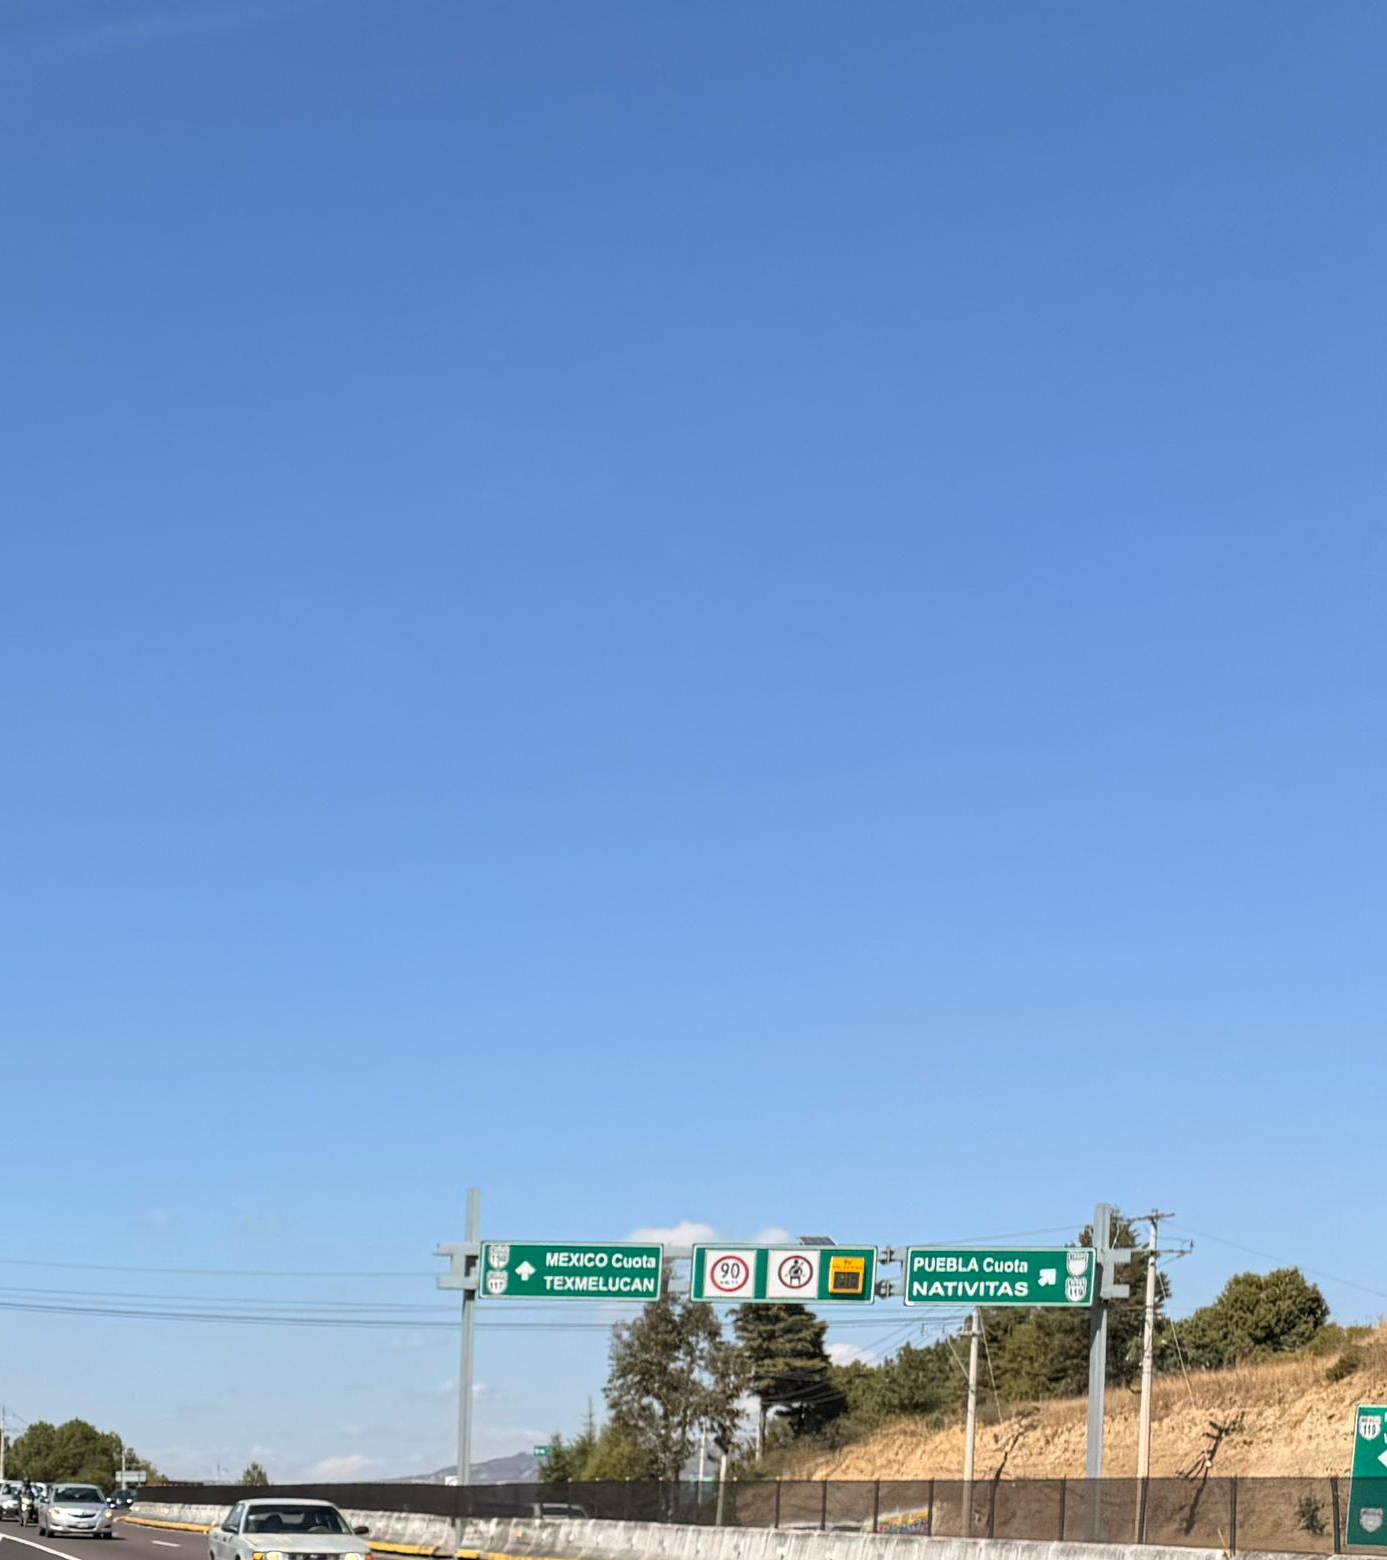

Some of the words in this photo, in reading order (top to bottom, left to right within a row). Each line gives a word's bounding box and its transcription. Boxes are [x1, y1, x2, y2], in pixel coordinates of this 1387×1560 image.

[545, 1252, 608, 1267] MEXICO
[611, 1253, 657, 1269] Cuota
[914, 1256, 979, 1273] PUEBLA
[983, 1257, 1029, 1274] Cuota
[720, 1262, 741, 1279] 90
[544, 1275, 655, 1293] TEXMELUCAN
[912, 1281, 1029, 1297] NATIVITAS
